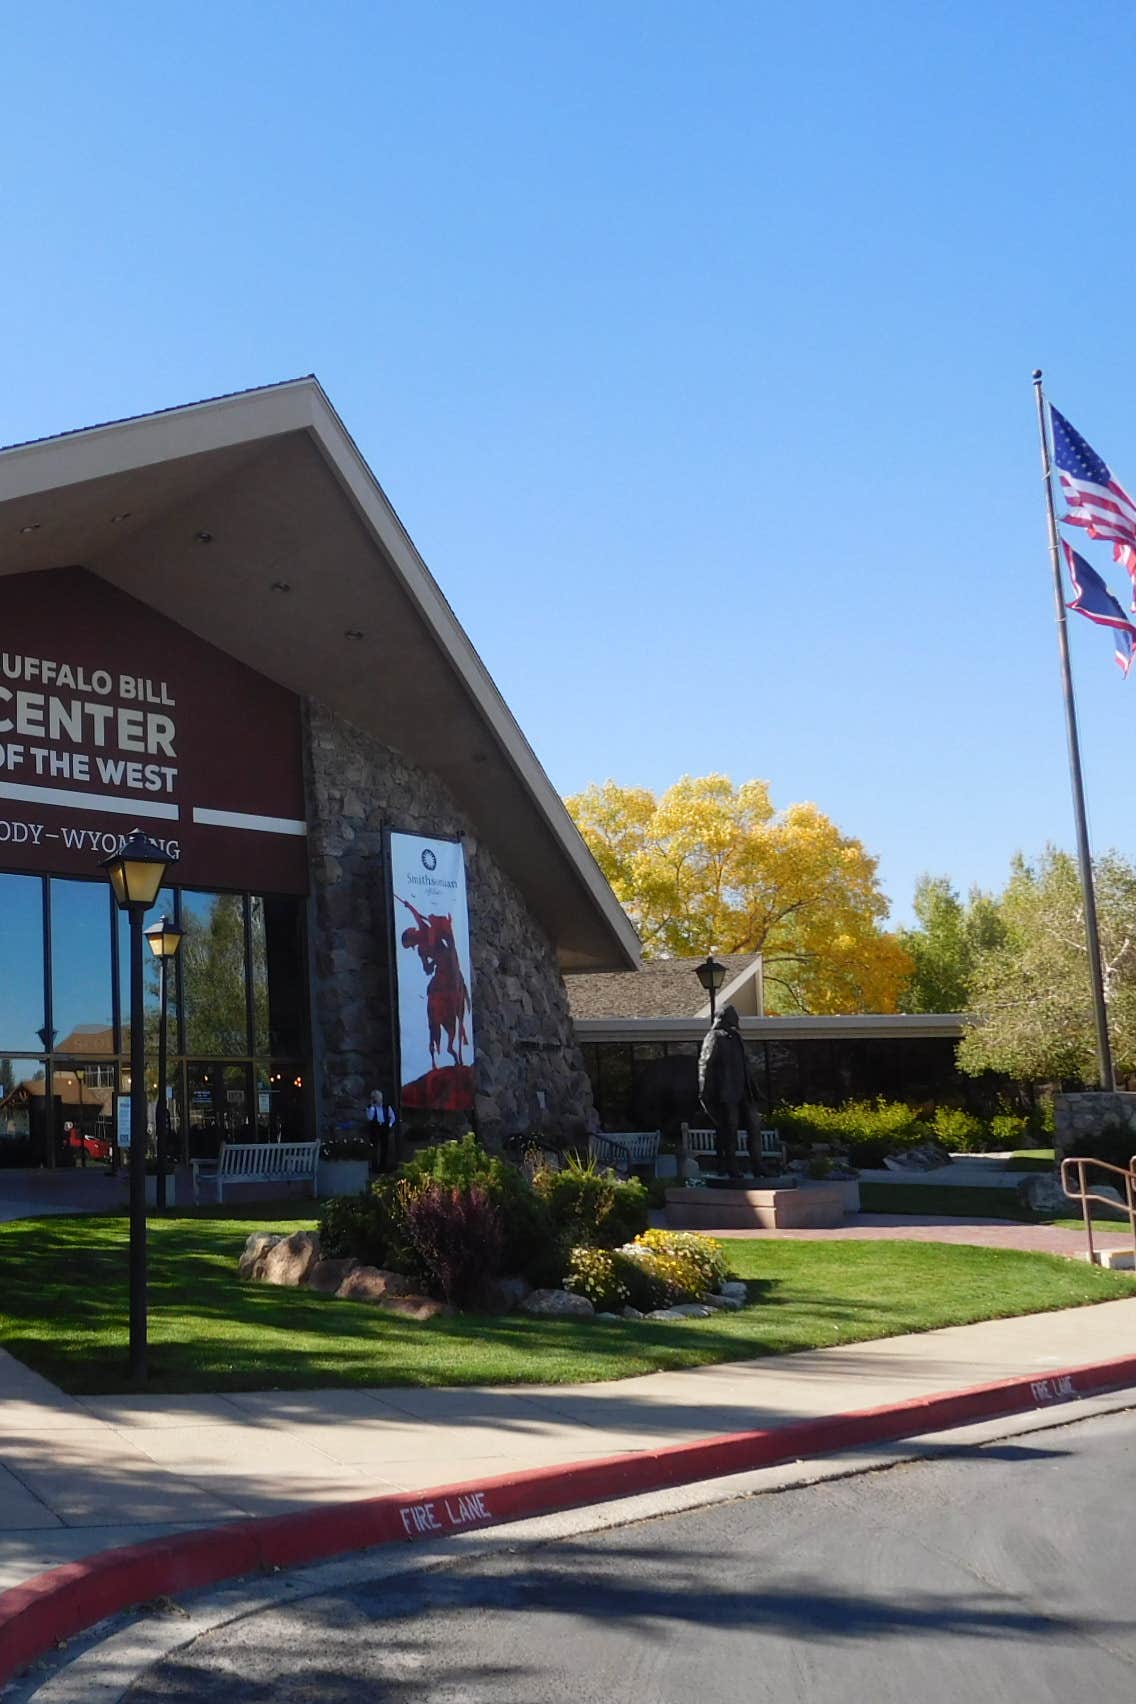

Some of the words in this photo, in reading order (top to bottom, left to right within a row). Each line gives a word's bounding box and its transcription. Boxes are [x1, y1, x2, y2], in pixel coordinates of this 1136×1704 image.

[119, 674, 176, 706] BILL
[30, 747, 90, 781] THE
[96, 756, 178, 792] WEST
[407, 872, 458, 888] Smithsonian
[1030, 1380, 1053, 1401] FIRE
[1052, 1375, 1074, 1396] LANE
[399, 1503, 442, 1535] FIRE
[444, 1492, 492, 1524] LANE
